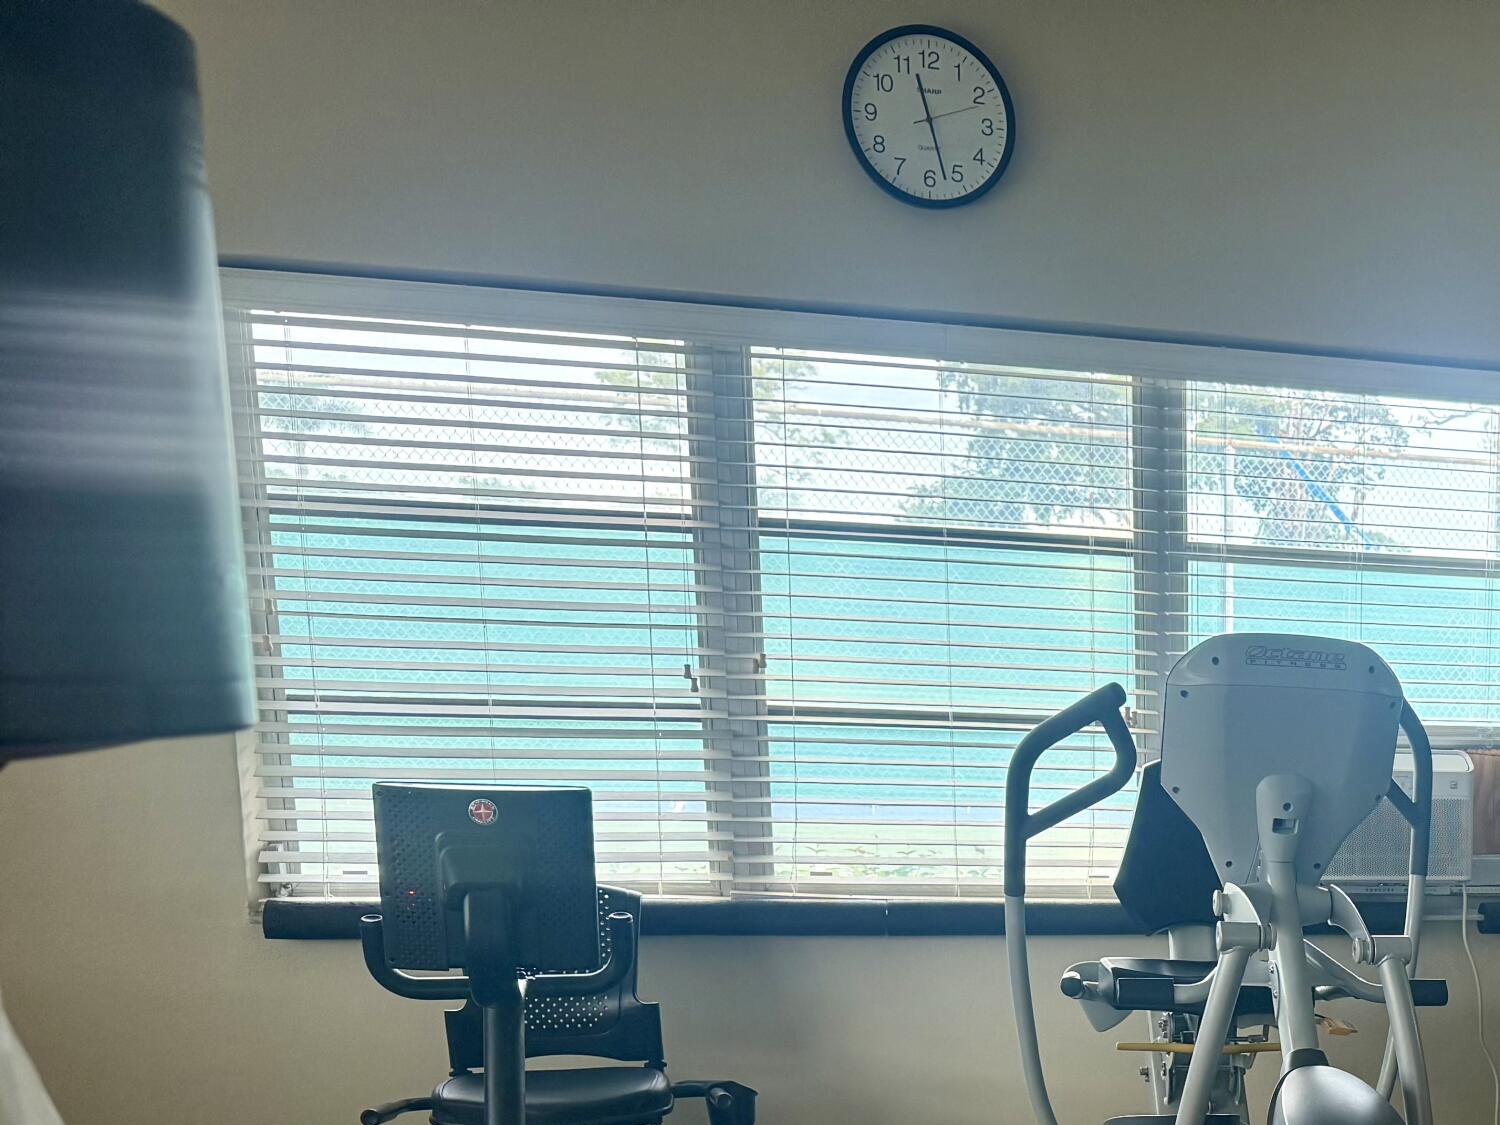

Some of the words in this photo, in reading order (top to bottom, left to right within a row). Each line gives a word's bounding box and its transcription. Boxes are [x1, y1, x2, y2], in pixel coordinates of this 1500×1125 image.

[894, 56, 911, 74] 11
[918, 50, 940, 70] 12
[953, 64, 961, 82] 1
[873, 74, 894, 92] 10
[973, 87, 985, 105] 2
[864, 103, 877, 121] 9
[981, 118, 994, 136] 3
[873, 135, 886, 153] 8
[973, 148, 985, 165] 4
[894, 157, 906, 176] 7
[951, 164, 963, 183] 5
[924, 169, 936, 187] 6
